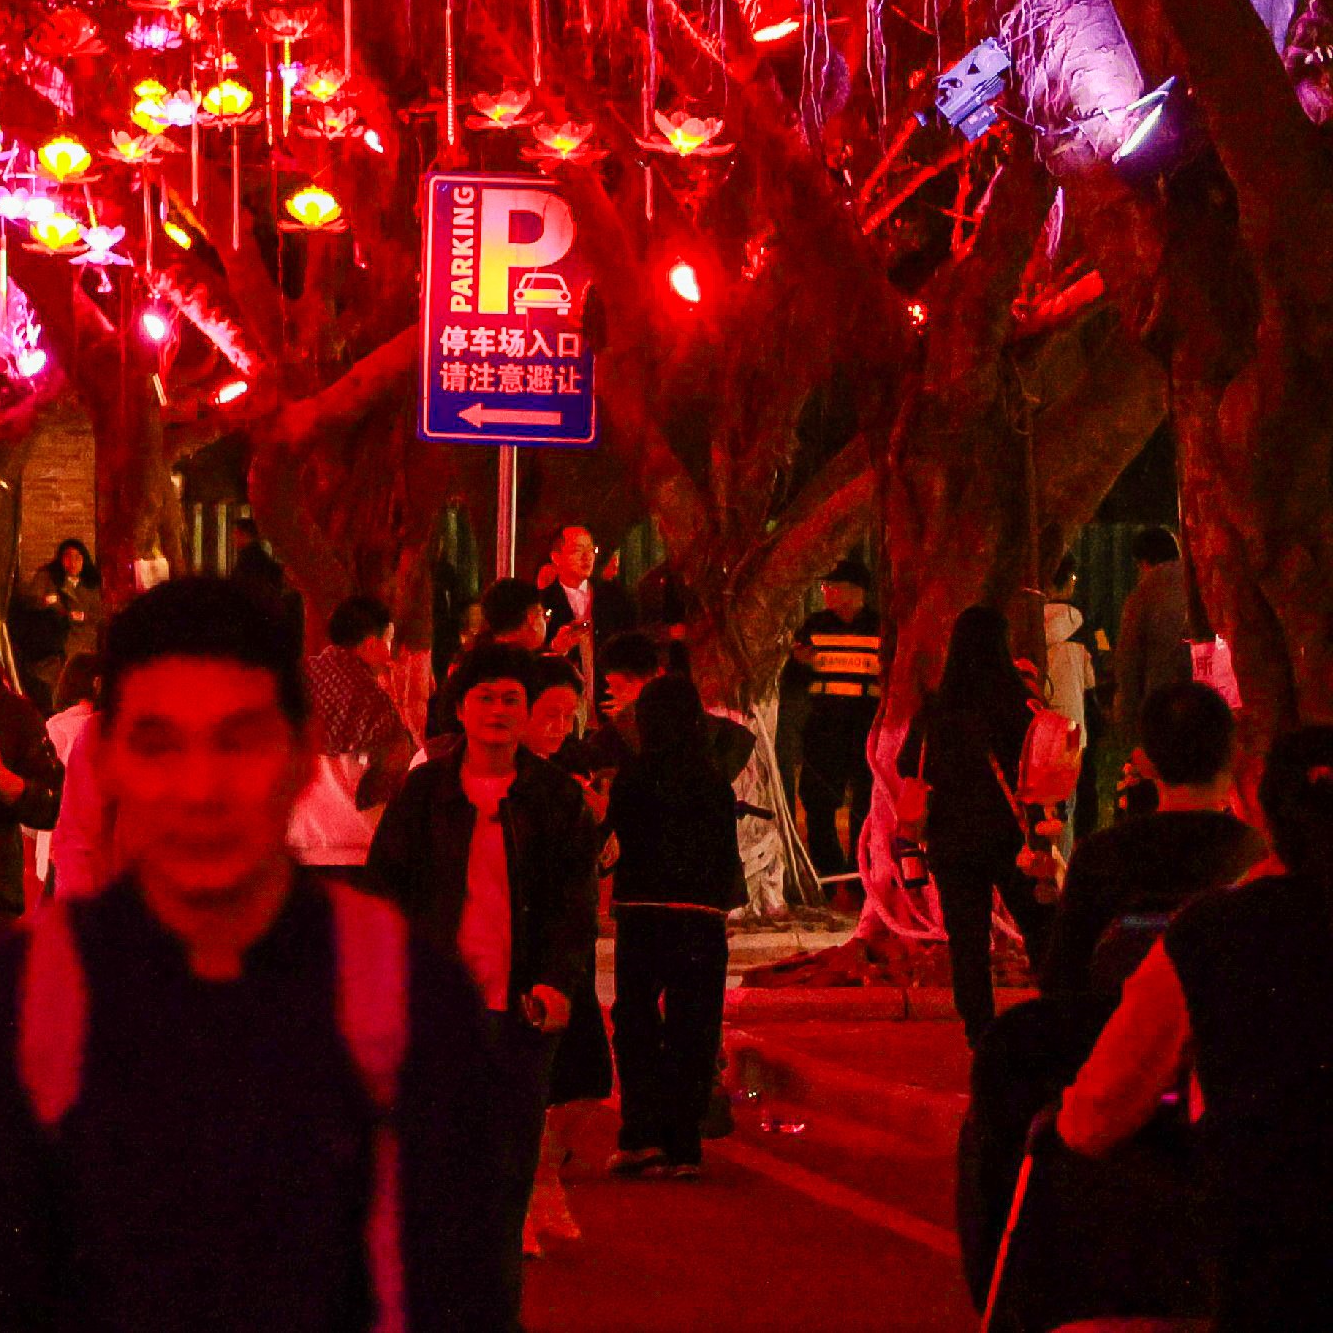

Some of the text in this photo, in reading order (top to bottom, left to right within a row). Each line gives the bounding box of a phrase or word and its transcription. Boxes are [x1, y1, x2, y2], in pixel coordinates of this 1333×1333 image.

[451, 185, 475, 313] PARKING
[478, 187, 575, 314] P
[439, 362, 581, 394] 请注意避让
[440, 325, 580, 358] 停车场入口
